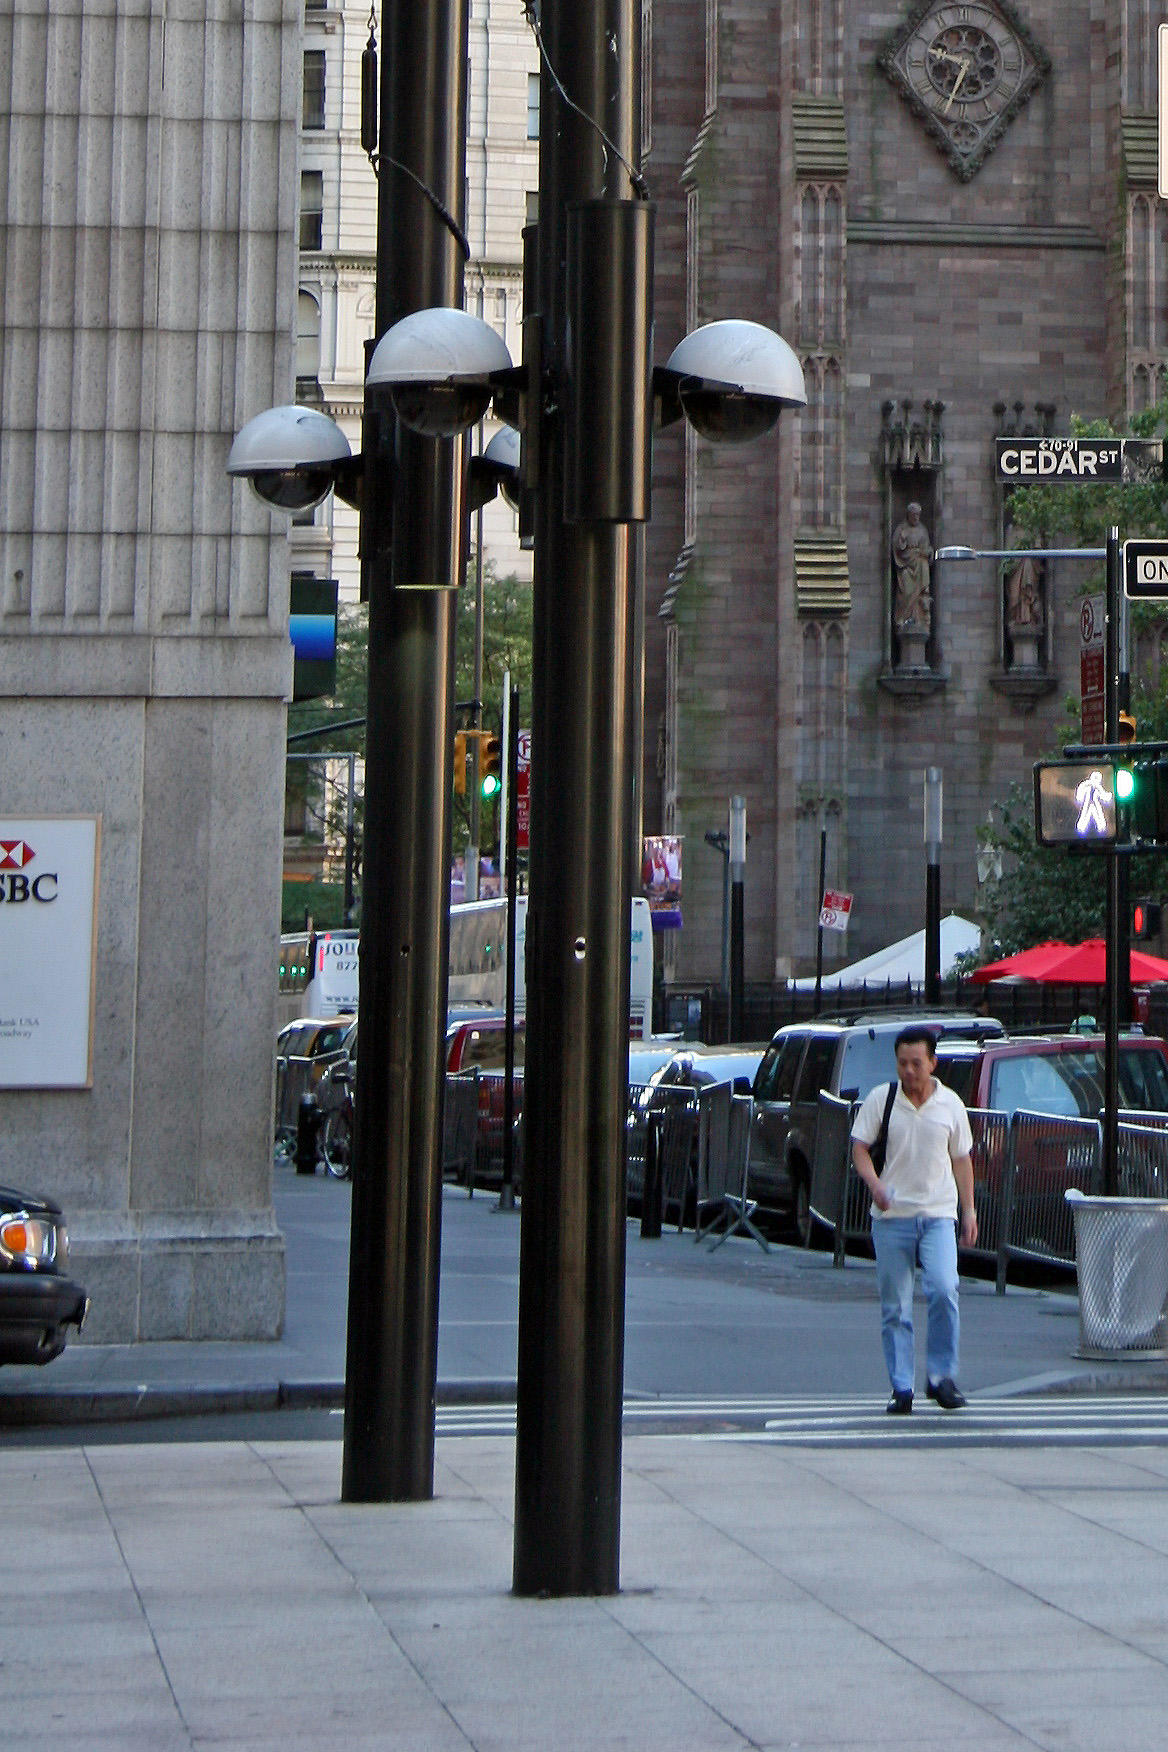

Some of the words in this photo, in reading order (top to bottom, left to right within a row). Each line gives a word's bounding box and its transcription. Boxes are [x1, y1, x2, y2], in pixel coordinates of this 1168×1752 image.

[1000, 450, 1098, 475] CEDAR
[1099, 450, 1118, 464] ST
[0, 873, 58, 903] BC
